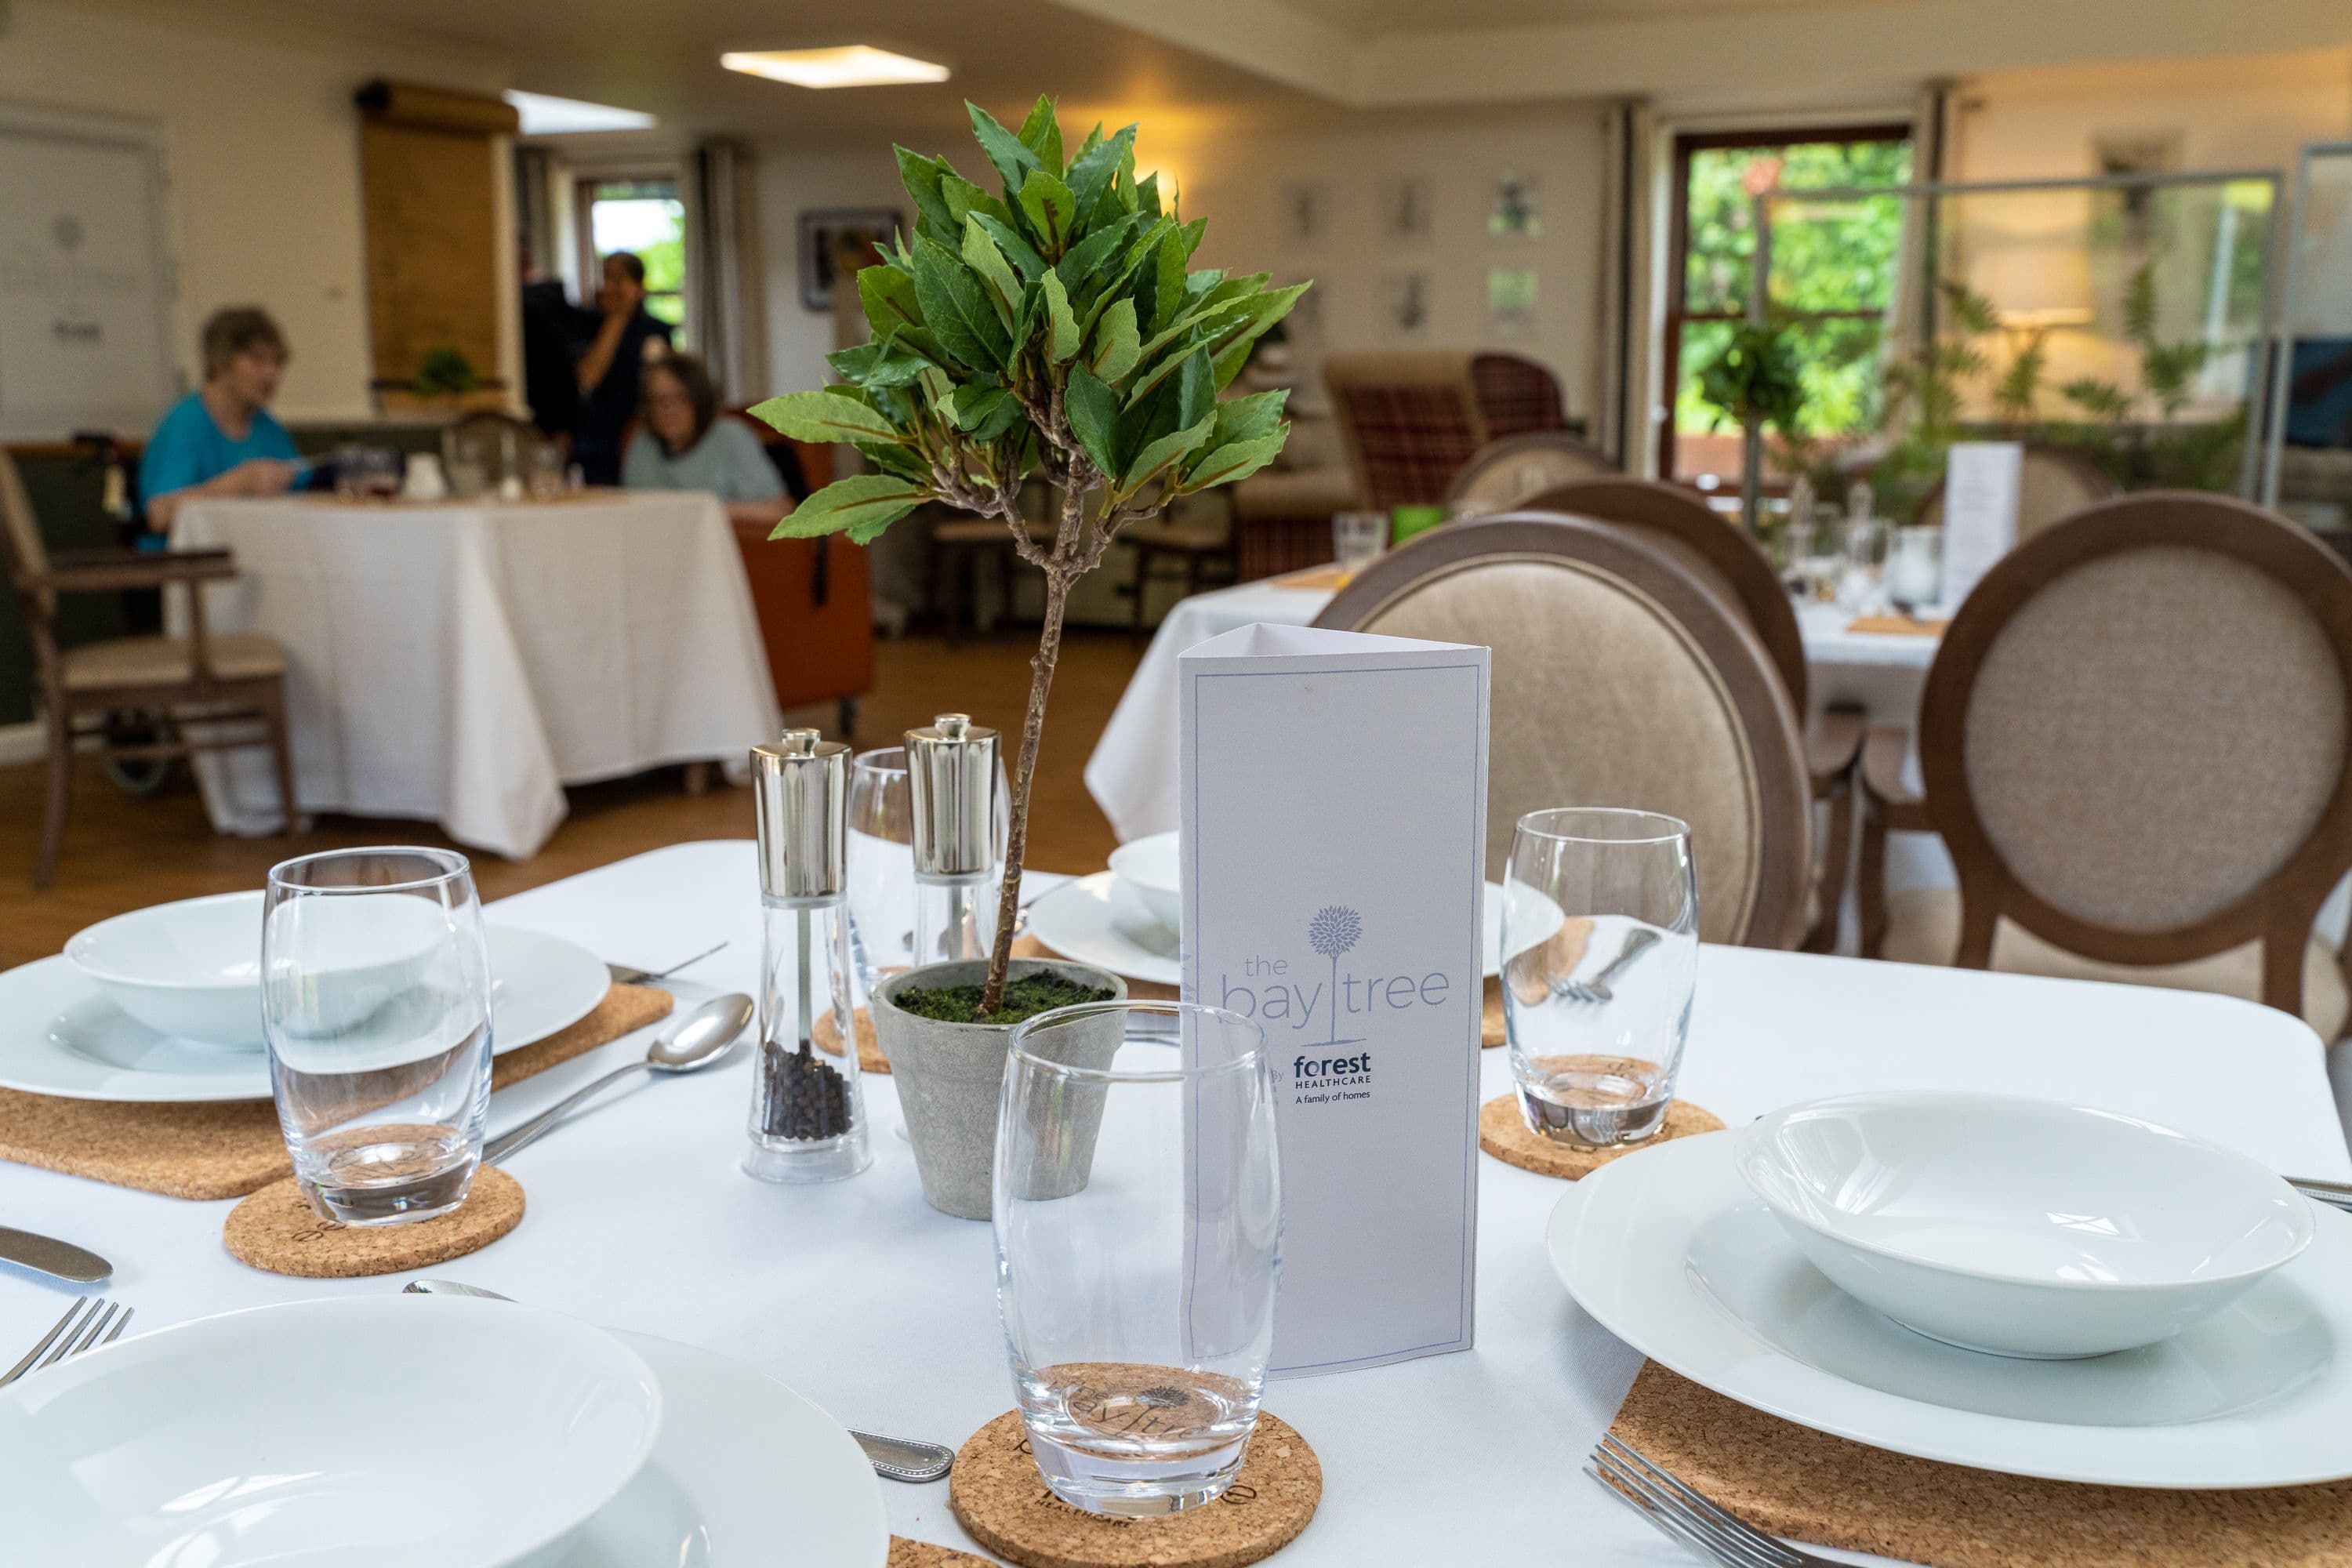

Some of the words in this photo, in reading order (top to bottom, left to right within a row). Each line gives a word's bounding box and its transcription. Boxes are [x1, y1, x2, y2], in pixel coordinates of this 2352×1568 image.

[1244, 955, 1288, 977] the
[1219, 974, 1323, 1029] bay
[1343, 971, 1450, 1014] tree
[1294, 1052, 1371, 1078] forest
[1295, 1075, 1371, 1090] HEALTHCARE
[1305, 1093, 1330, 1105] family
[1332, 1091, 1341, 1101] of
[1343, 1091, 1370, 1100] homes
